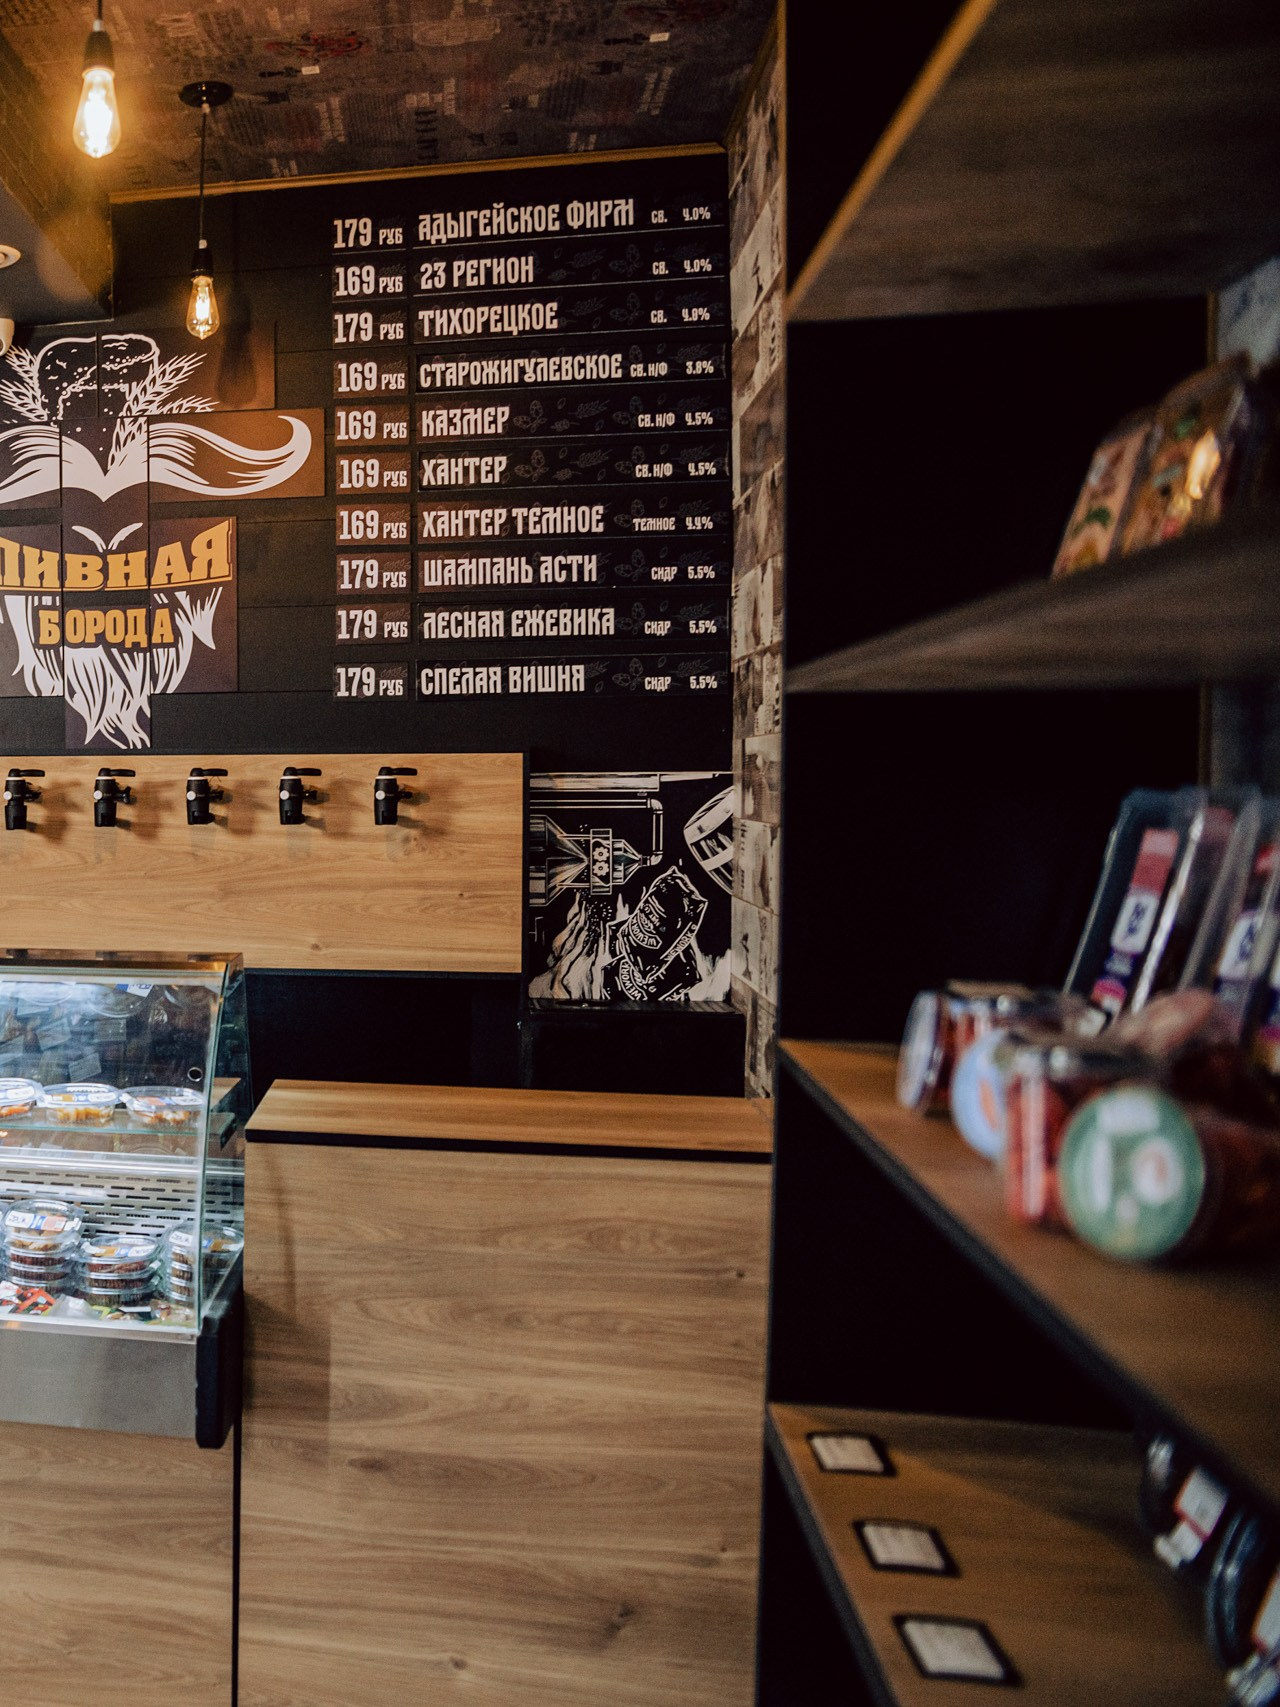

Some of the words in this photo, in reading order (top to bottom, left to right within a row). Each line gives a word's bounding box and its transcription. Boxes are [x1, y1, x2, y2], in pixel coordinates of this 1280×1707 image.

[333, 217, 372, 248] 179
[379, 228, 403, 245] РУБ
[418, 203, 560, 244] АДЫГЕЙСКОЕ
[566, 198, 634, 228] ФИРМ
[651, 210, 668, 224] СВ.
[682, 206, 711, 221] 4.0%
[335, 265, 376, 296] 169
[379, 276, 403, 293] РУБ
[420, 262, 446, 290] 23
[452, 256, 534, 287] РЕГИОН
[652, 261, 668, 275] СВ.
[684, 258, 712, 273] 4.0%
[334, 312, 373, 344] 179
[380, 323, 404, 340] РУБ
[418, 302, 558, 337] ТИХОРЕЦКОЕ
[650, 310, 667, 324] СВ.
[338, 361, 378, 392] 169
[381, 374, 405, 390] РУБ
[420, 354, 622, 388] СТАРОЖИГУЛЕВСКОЕ
[686, 360, 714, 374] 3.8%
[336, 410, 377, 440] 169
[383, 422, 407, 438] РУБ
[422, 406, 510, 438] КАЗМЕР
[685, 412, 713, 426] 4.5%
[339, 458, 380, 489] 169
[384, 470, 408, 487] РУБ
[422, 456, 508, 486] ХАНТЕР
[688, 462, 716, 476] 4.5%
[339, 510, 380, 540] 169
[383, 522, 407, 539] РУБ
[422, 508, 507, 538] ХАНТЕР
[512, 505, 604, 534] ТЕМНОЕ
[632, 517, 676, 532] ТЕМНОЕ
[340, 559, 379, 590] 179
[382, 571, 407, 588] РУБ
[424, 556, 533, 586] ШАМПАНЬ
[540, 554, 597, 584] АСТИ
[651, 566, 678, 582] СИДР
[688, 566, 716, 579] 5.5%
[38, 608, 174, 648] БОРОДА
[337, 608, 377, 640] 179
[384, 622, 408, 638] РУБ
[423, 608, 504, 639] ЛЕСНАЯ
[511, 608, 614, 636] ЕЖЕВИКА
[644, 620, 671, 636] СИДР
[689, 620, 717, 634] 5.5%
[336, 666, 375, 697] 179
[379, 680, 404, 696] РУБ
[420, 666, 502, 696] СПЕЛАЯ
[508, 664, 585, 694] ВИШНЯ
[644, 676, 671, 692] СИДР
[690, 675, 718, 690] 5.5%
[621, 963, 641, 1000] WEWORK
